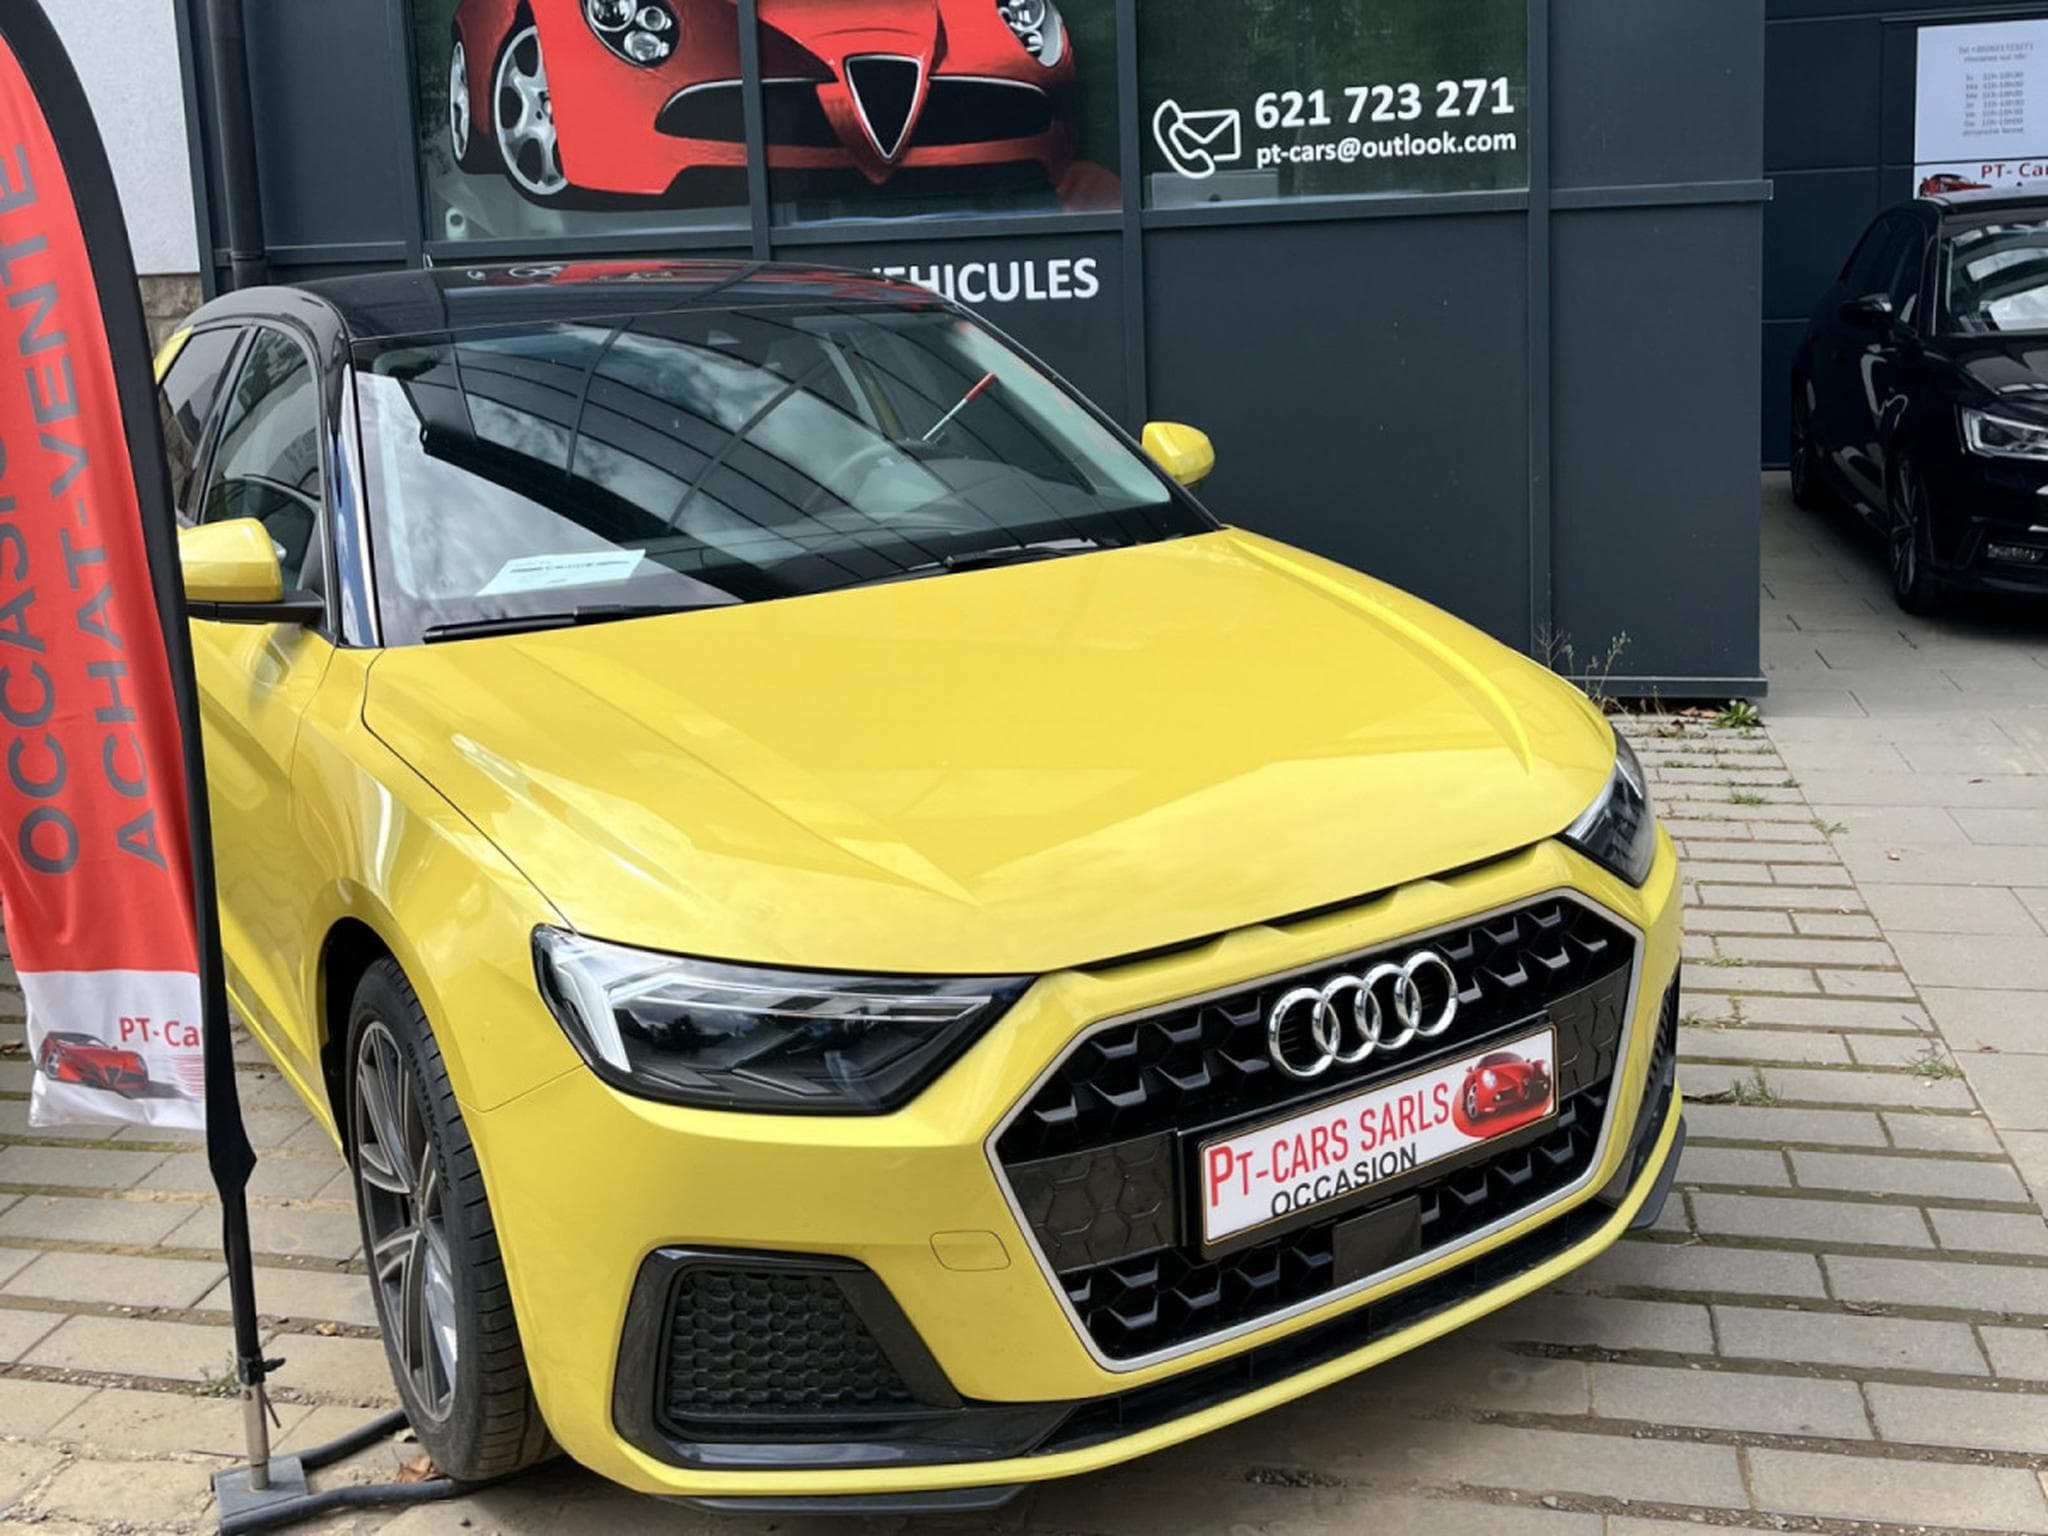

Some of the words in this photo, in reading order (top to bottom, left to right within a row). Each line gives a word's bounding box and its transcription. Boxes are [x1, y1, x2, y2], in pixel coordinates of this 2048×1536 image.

[1255, 89, 1331, 129] 621
[1344, 83, 1422, 123] 723
[1436, 77, 1515, 118] 271
[1256, 130, 1517, 169] pt-cars@outlook.com
[872, 257, 1099, 303] HICULES
[0, 143, 169, 873] ACHAT-VENTE
[119, 1017, 202, 1047] PT-Ca
[1209, 1118, 1348, 1207] PT-CARS
[1360, 1082, 1449, 1152] SARLS
[1271, 1142, 1416, 1218] OCCASION
